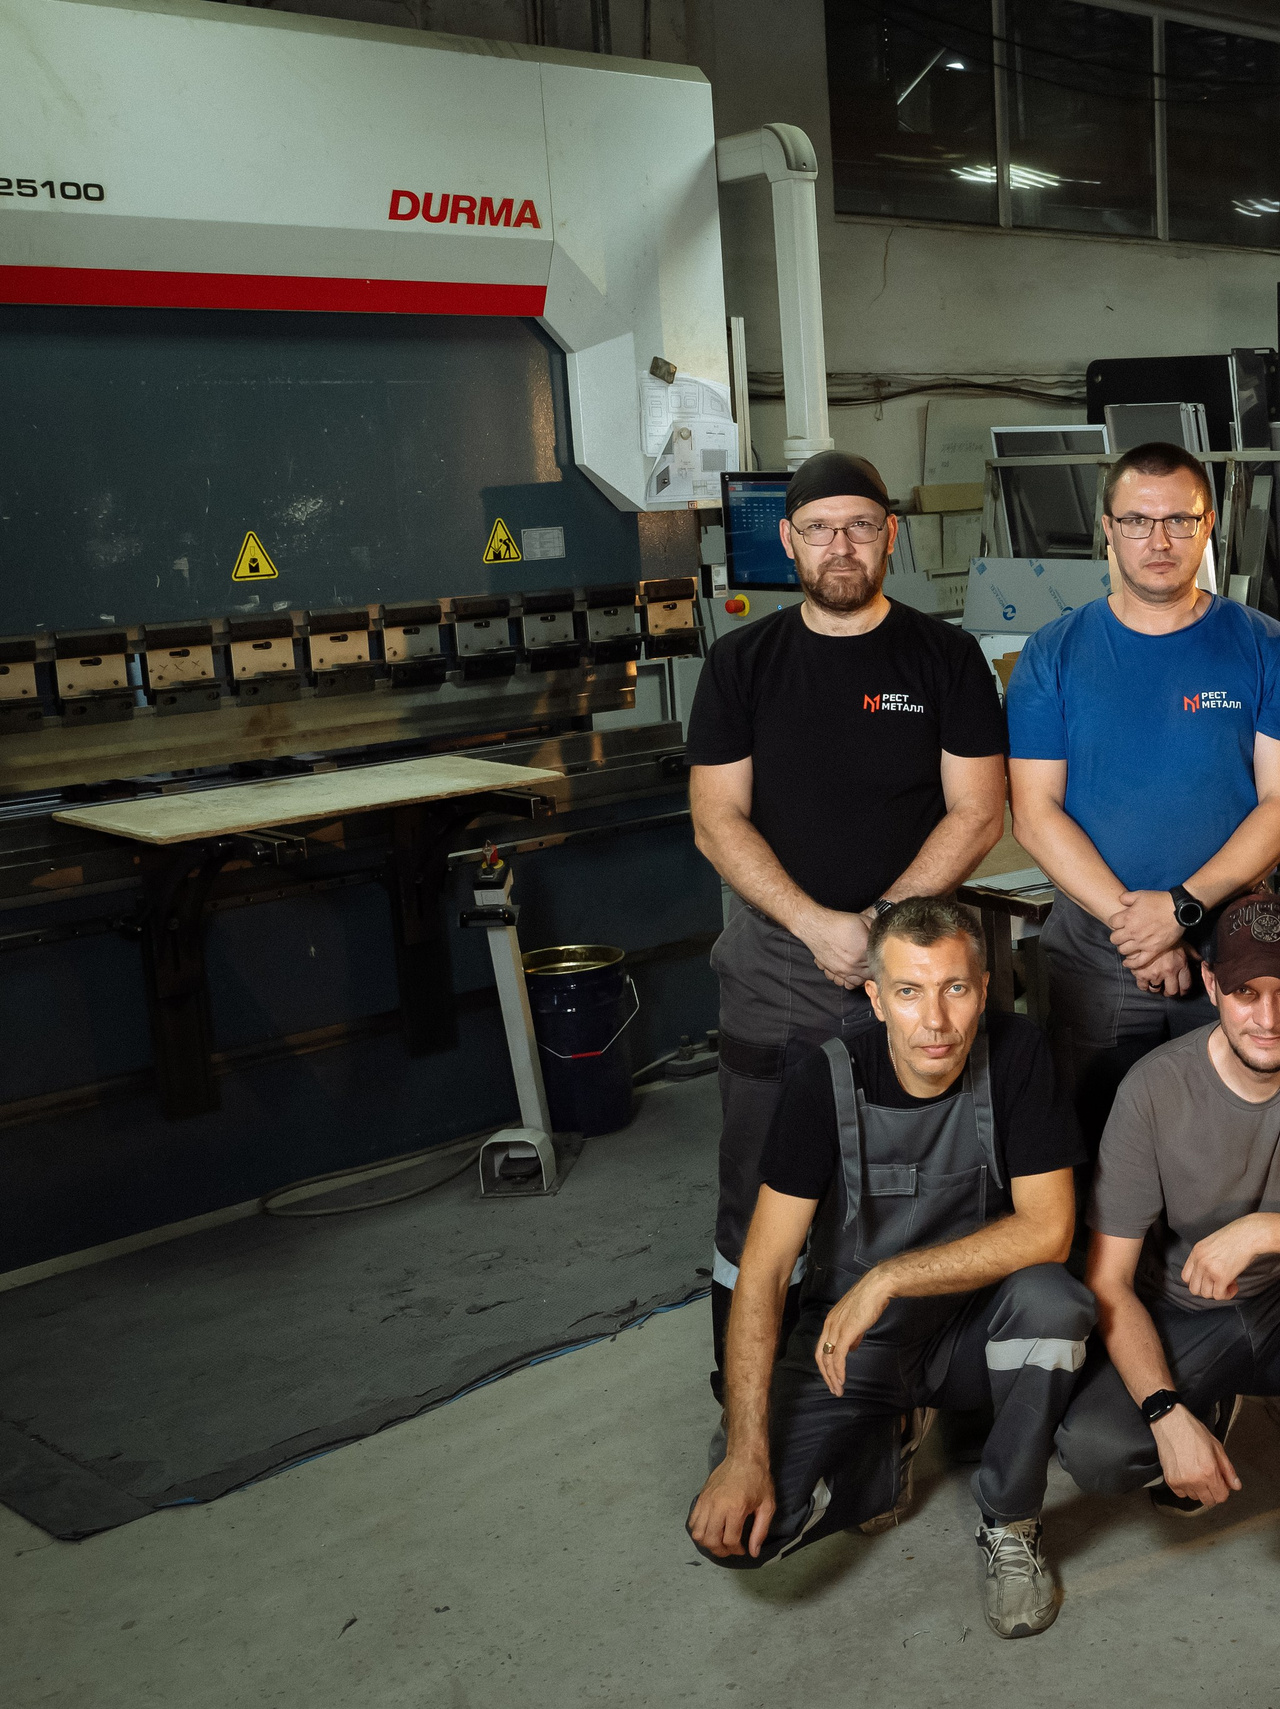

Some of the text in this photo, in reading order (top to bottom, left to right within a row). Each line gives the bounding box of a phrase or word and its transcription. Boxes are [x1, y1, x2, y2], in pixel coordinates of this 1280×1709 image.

[0, 177, 105, 201] 25100
[388, 189, 542, 229] DURMA
[882, 693, 909, 703] РЕСТ
[1201, 691, 1227, 700] РЕСТ
[881, 702, 924, 714] МЕТАЛЛ
[1201, 700, 1242, 710] МЕТАЛЛ
